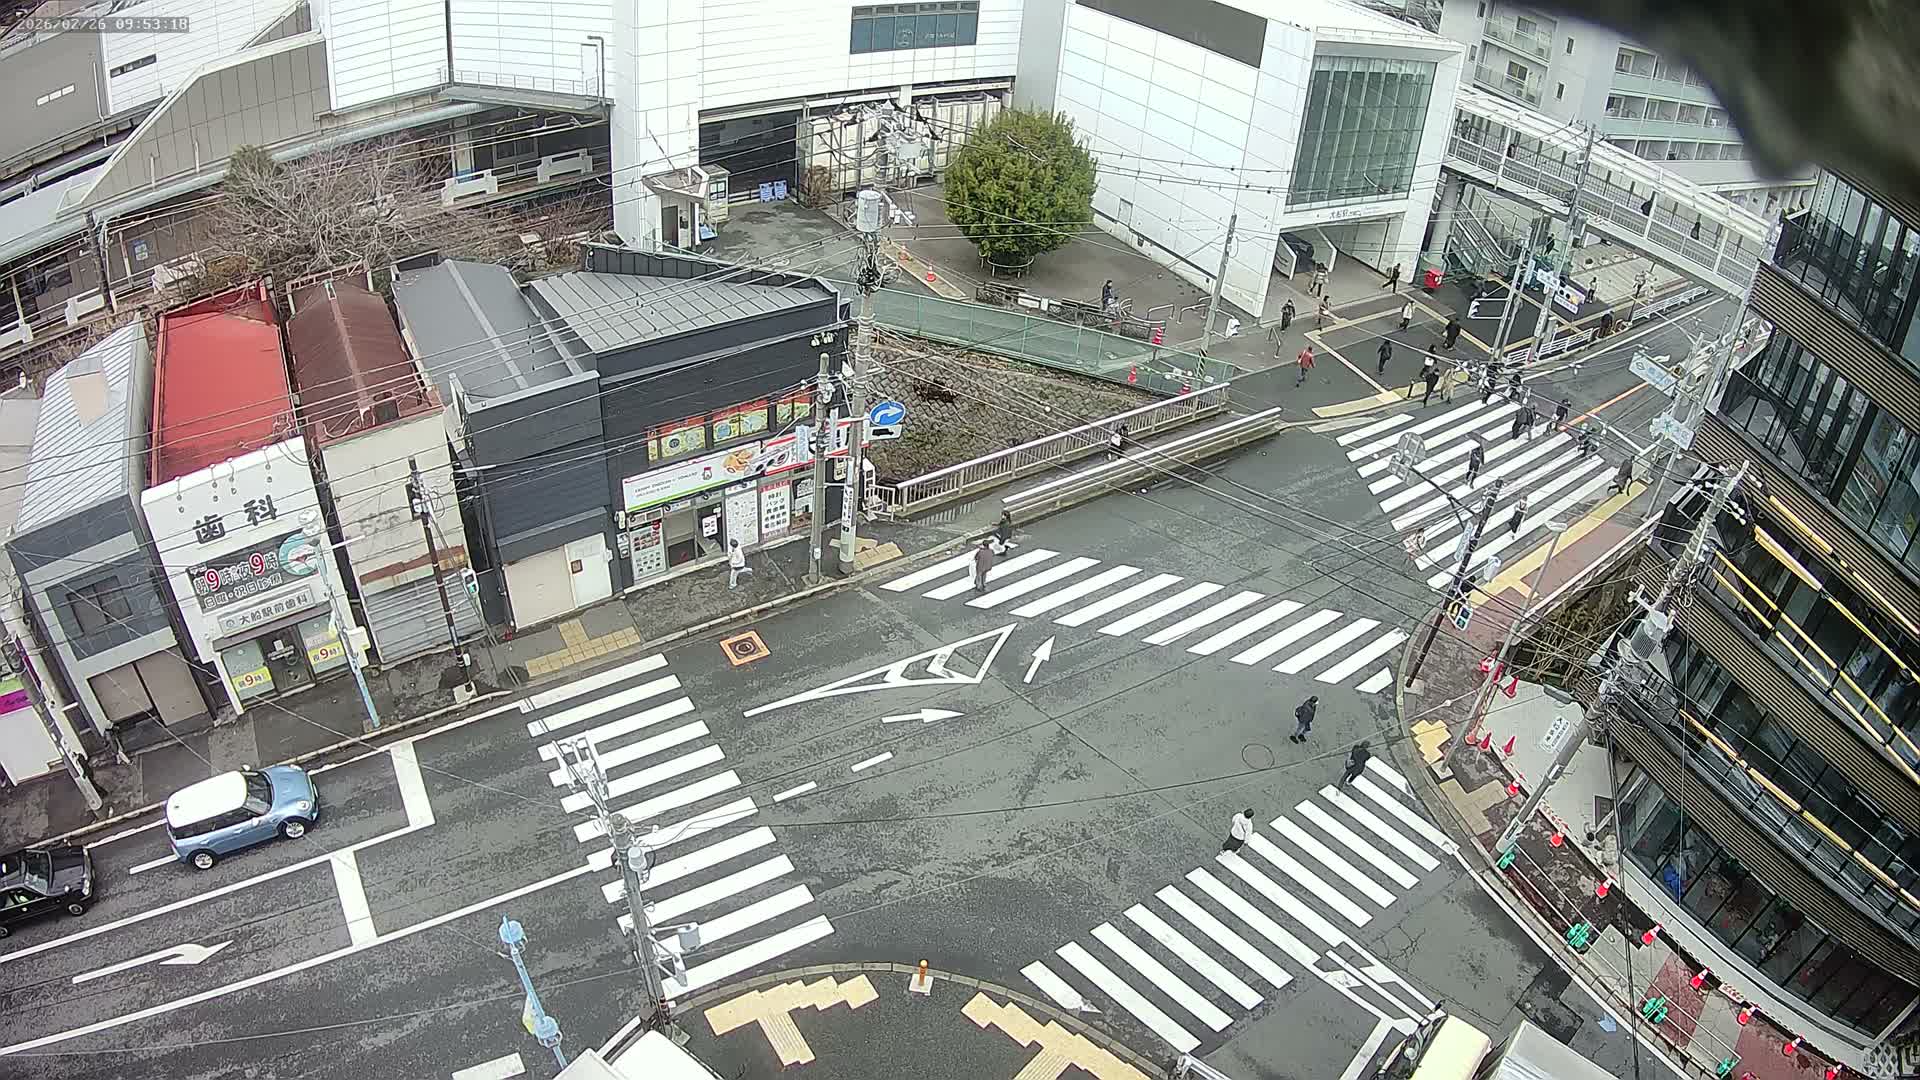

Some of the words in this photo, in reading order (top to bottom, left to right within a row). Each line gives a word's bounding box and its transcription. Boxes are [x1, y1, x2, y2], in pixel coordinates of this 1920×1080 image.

[193, 495, 278, 544] 歯科
[239, 594, 309, 625] 大船駅前歯科
